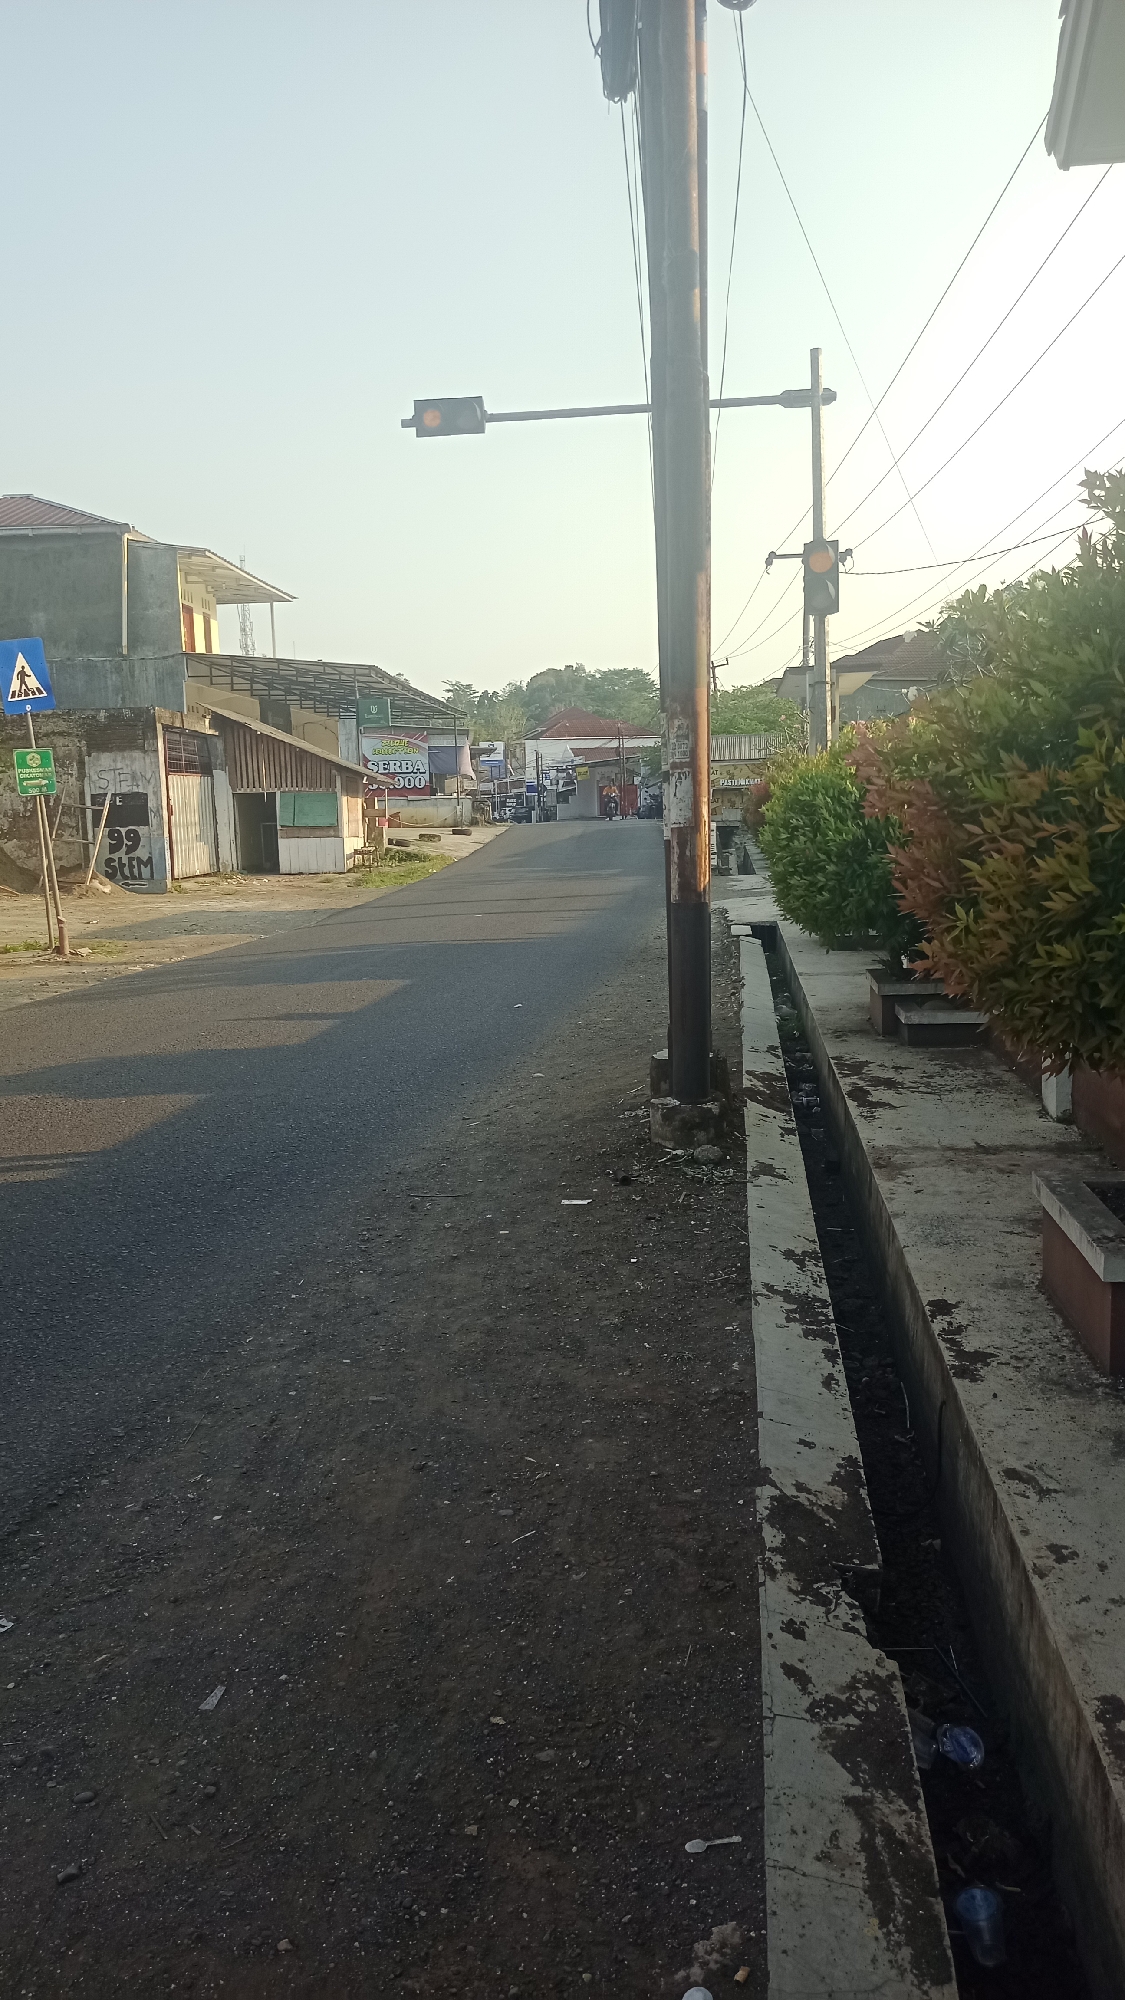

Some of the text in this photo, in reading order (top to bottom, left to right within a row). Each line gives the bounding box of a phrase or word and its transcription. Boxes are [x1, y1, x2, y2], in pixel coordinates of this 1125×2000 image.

[367, 760, 427, 774] SERBA
[720, 778, 738, 786] PASTI
[107, 828, 141, 855] 99
